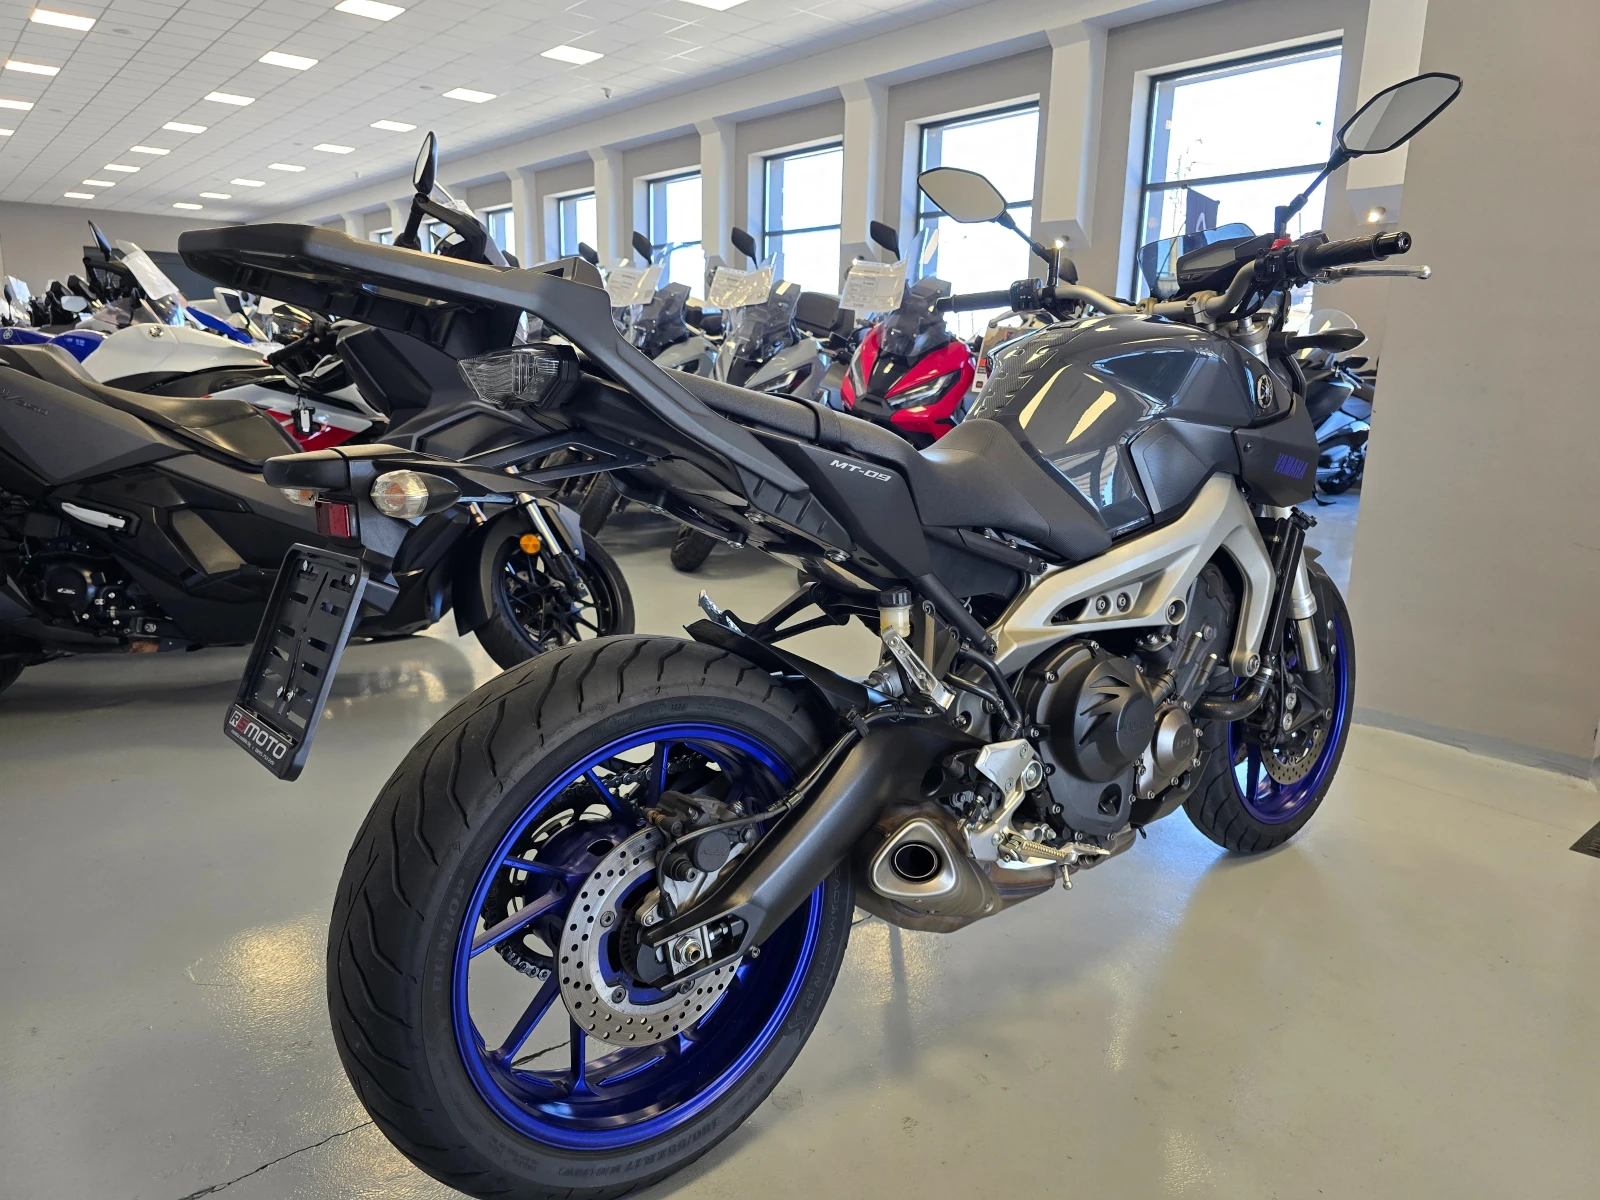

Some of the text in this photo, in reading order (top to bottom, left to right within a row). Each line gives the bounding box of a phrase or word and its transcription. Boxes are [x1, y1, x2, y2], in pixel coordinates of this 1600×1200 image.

[830, 459, 892, 482] MT-09
[1273, 452, 1309, 480] YAMAHA
[432, 878, 465, 992] DUNLOP
[820, 866, 842, 971] OADSMART
